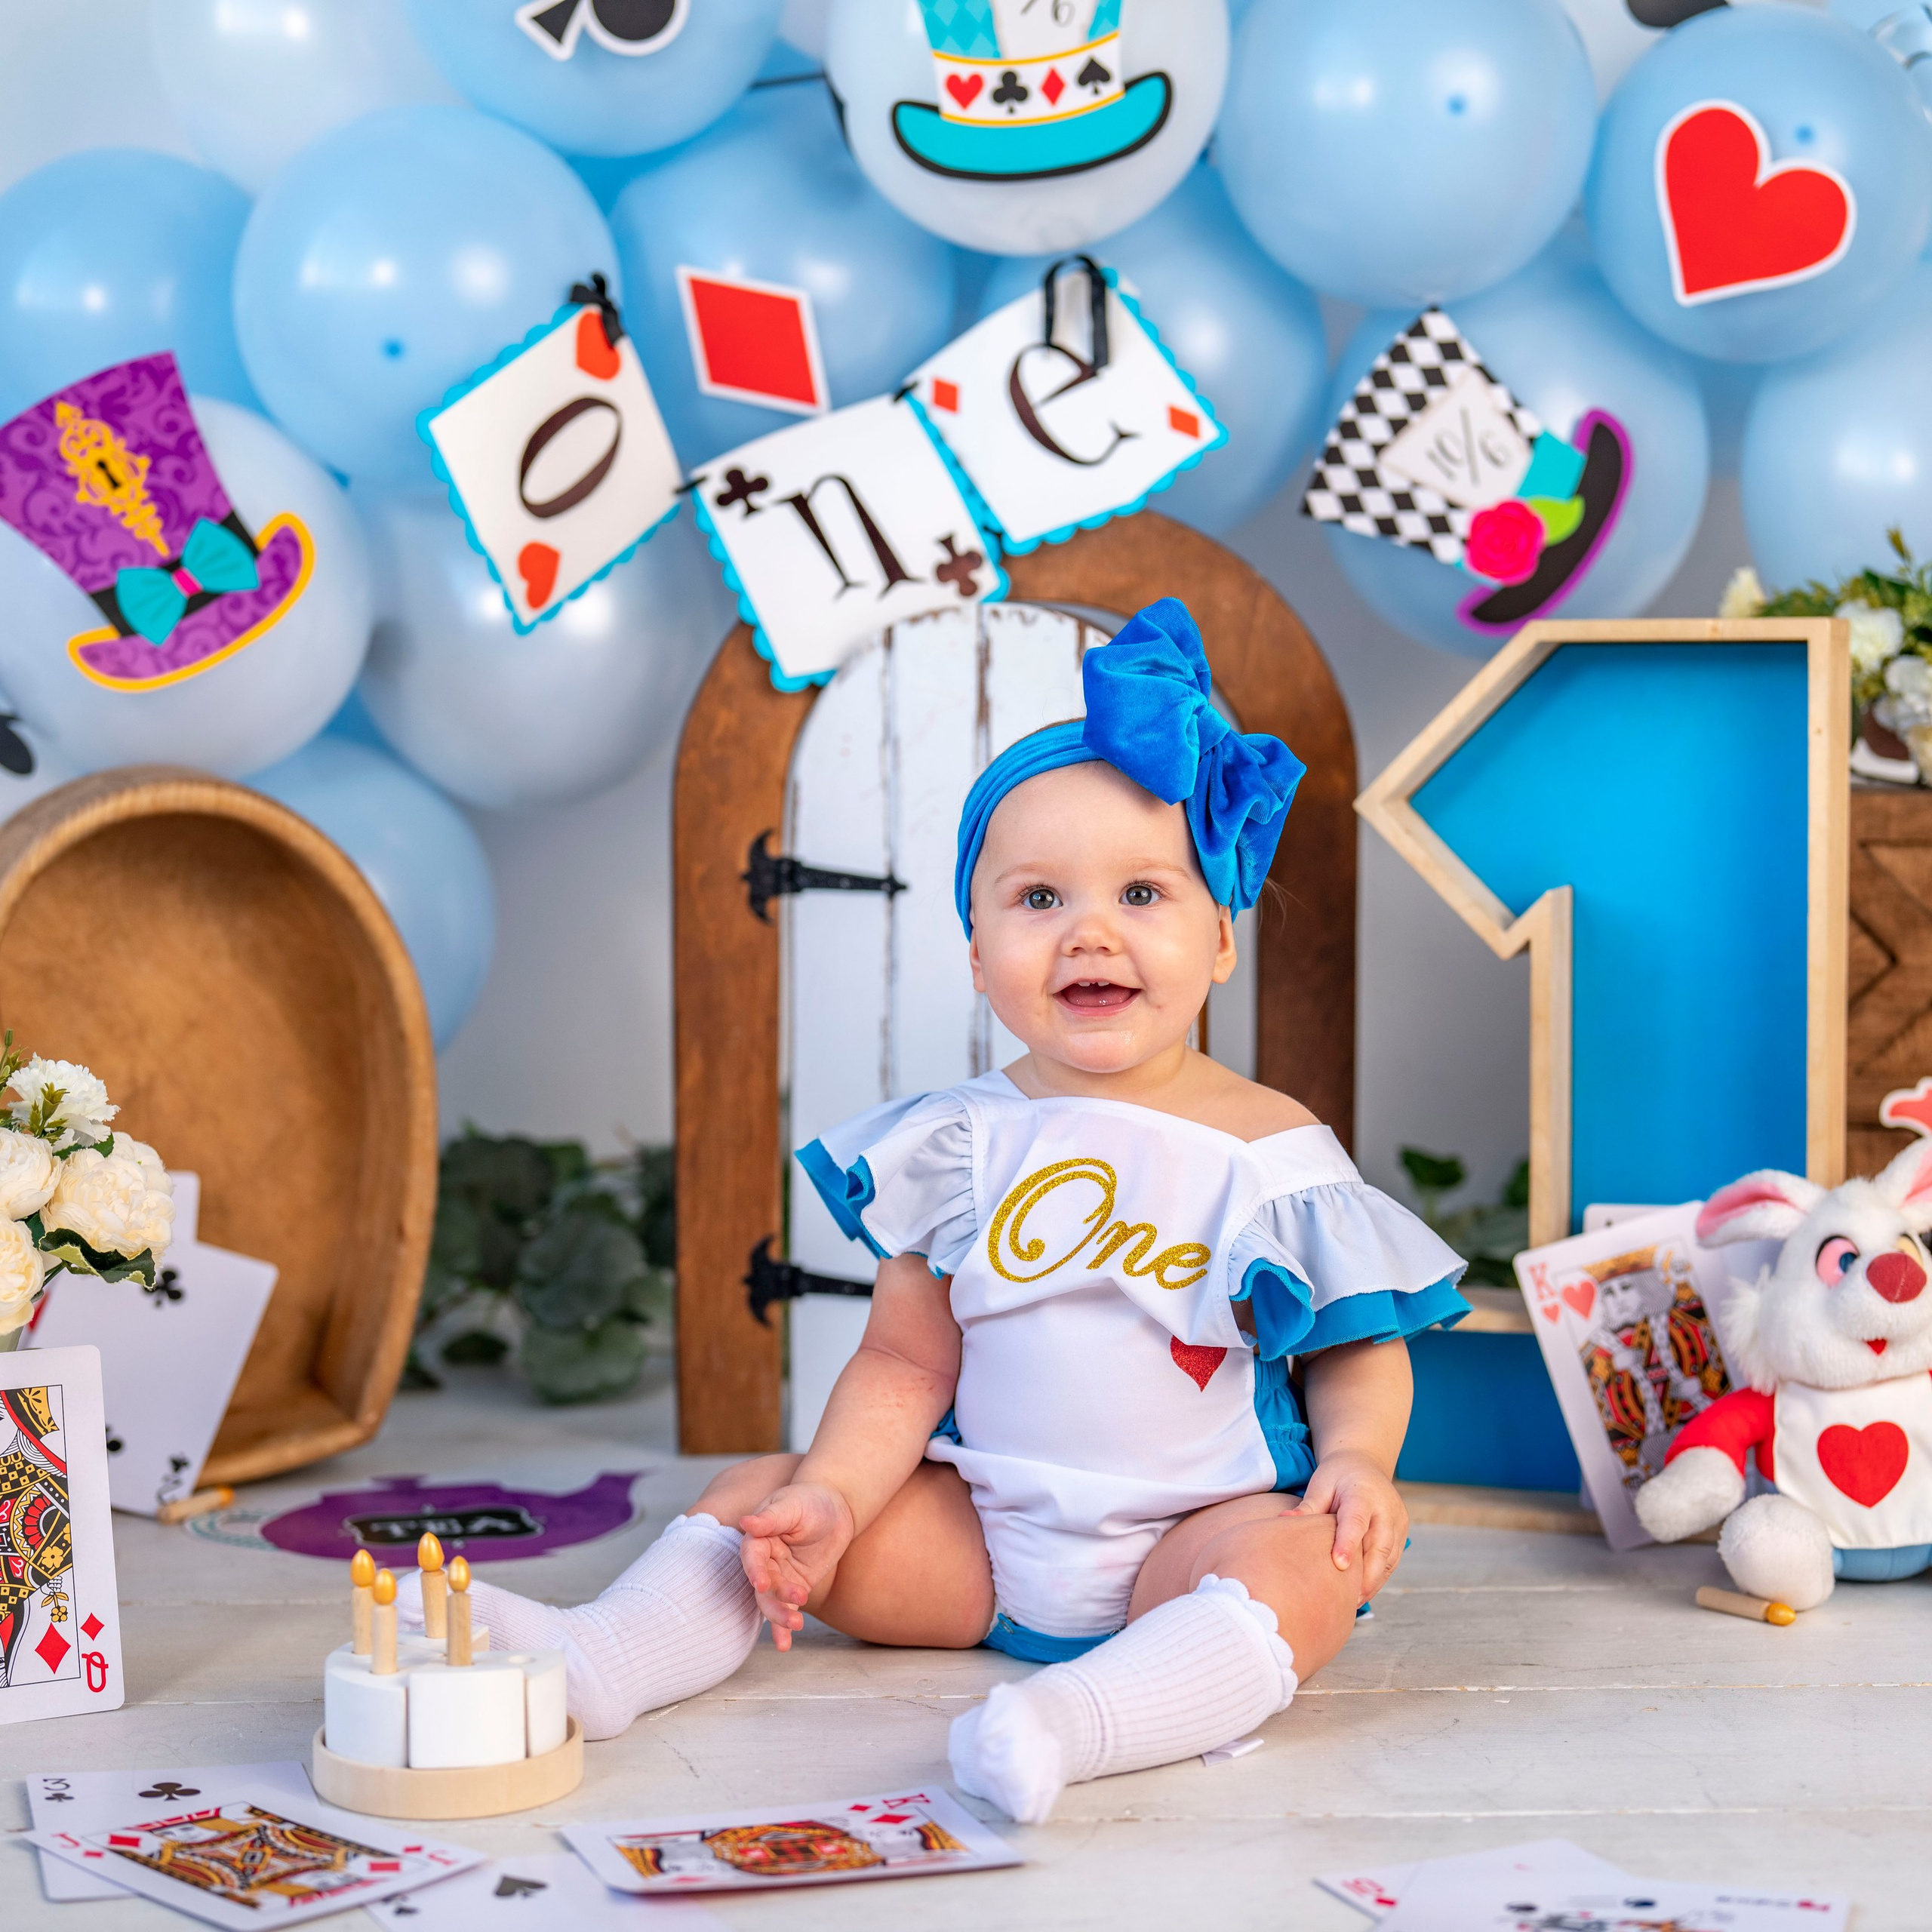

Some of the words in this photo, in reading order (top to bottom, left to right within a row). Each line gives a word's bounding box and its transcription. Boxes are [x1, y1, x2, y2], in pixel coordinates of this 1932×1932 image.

[1426, 405, 1511, 489] 10/6
[987, 1157, 1211, 1291] One
[1527, 1261, 1557, 1301] K
[81, 1651, 109, 1694] Q
[42, 1777, 71, 1791] 3
